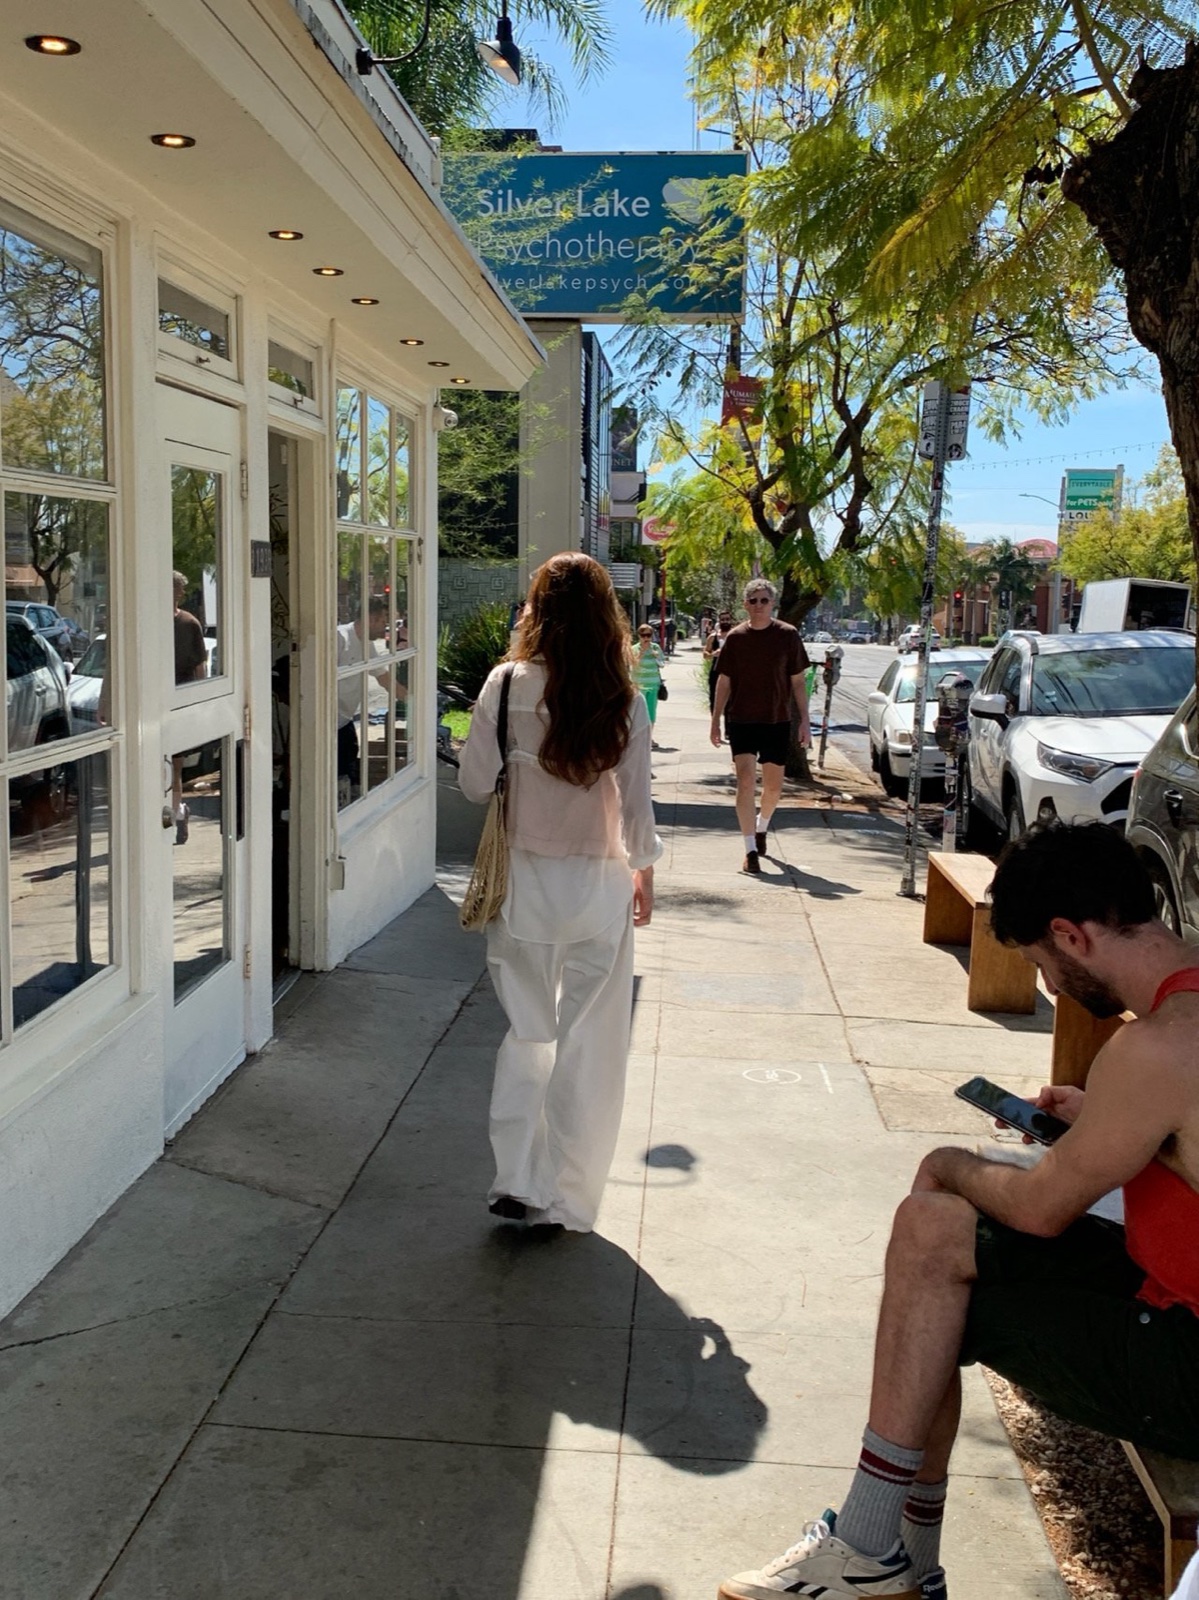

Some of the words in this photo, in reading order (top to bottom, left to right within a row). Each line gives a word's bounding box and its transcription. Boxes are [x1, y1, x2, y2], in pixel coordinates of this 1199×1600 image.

[477, 189, 569, 218] Silver
[577, 188, 650, 218] Lake
[478, 230, 702, 265] Psychotherapy
[1077, 498, 1097, 506] PETS
